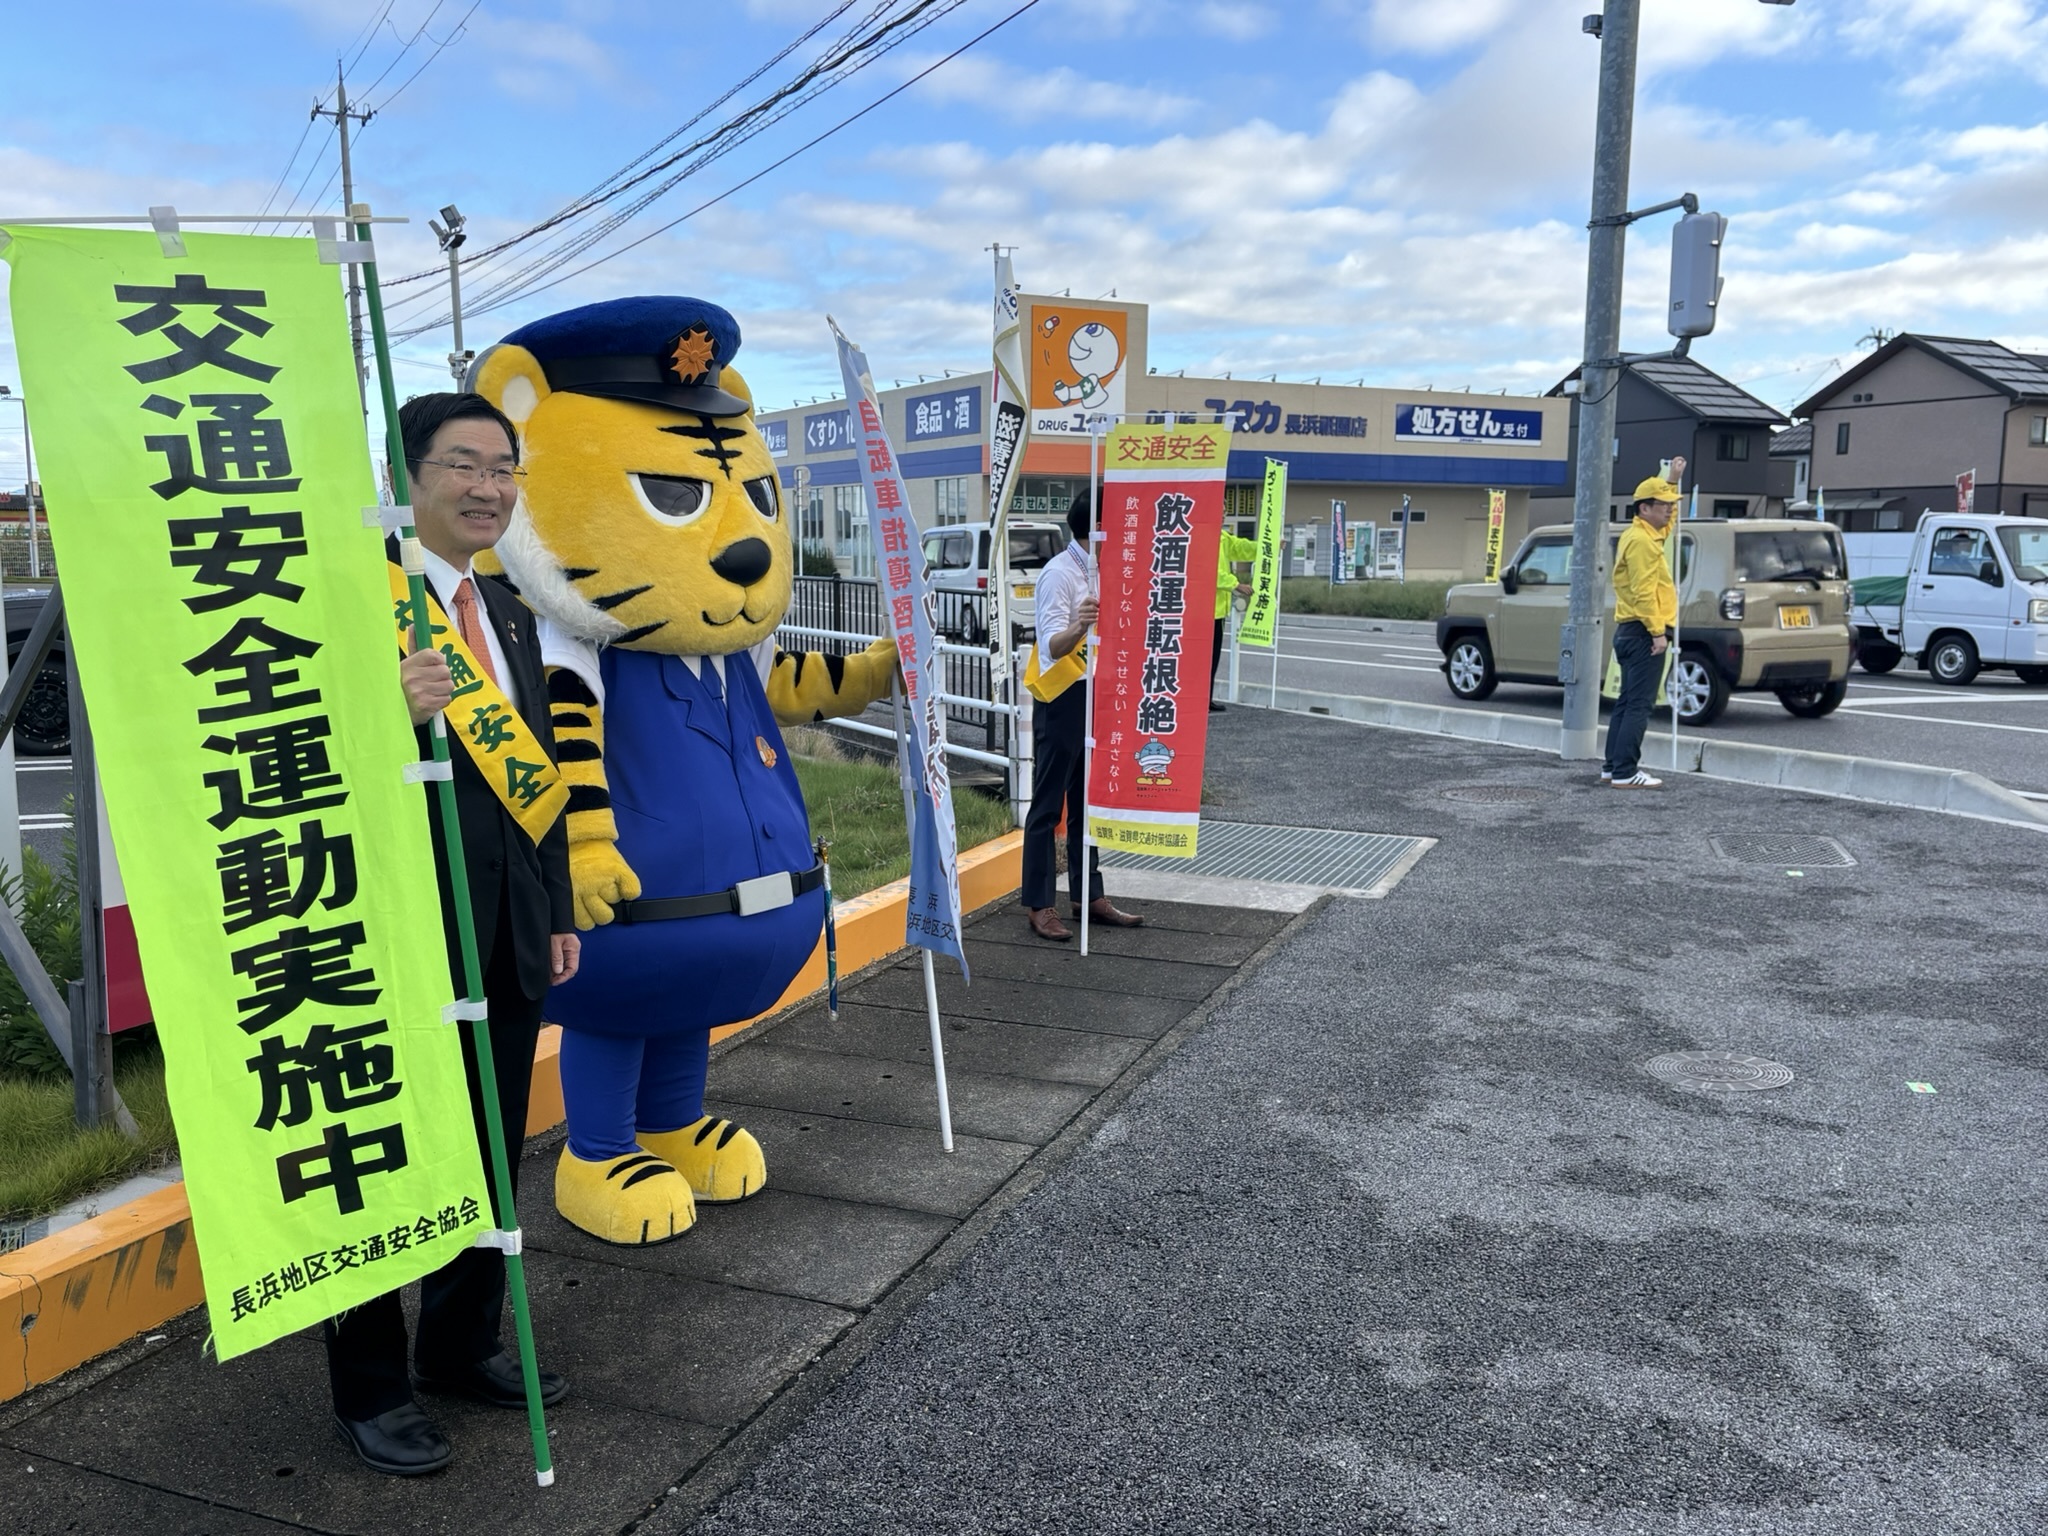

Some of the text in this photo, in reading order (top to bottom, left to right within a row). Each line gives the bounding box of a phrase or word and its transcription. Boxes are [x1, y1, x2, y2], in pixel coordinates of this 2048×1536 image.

[915, 395, 970, 435] 食品・酒
[1038, 419, 1068, 431] DRUG
[1118, 435, 1217, 461] 交通安全
[1411, 406, 1529, 438] 処方せん受付
[1108, 496, 1139, 793] 飲酒運転をしない・させない・許さない
[1136, 493, 1195, 735] 飲酒運転根絶
[115, 275, 408, 1216] 交通安全運動実施中
[230, 1196, 480, 1323] 長浜地区交通安全協会
